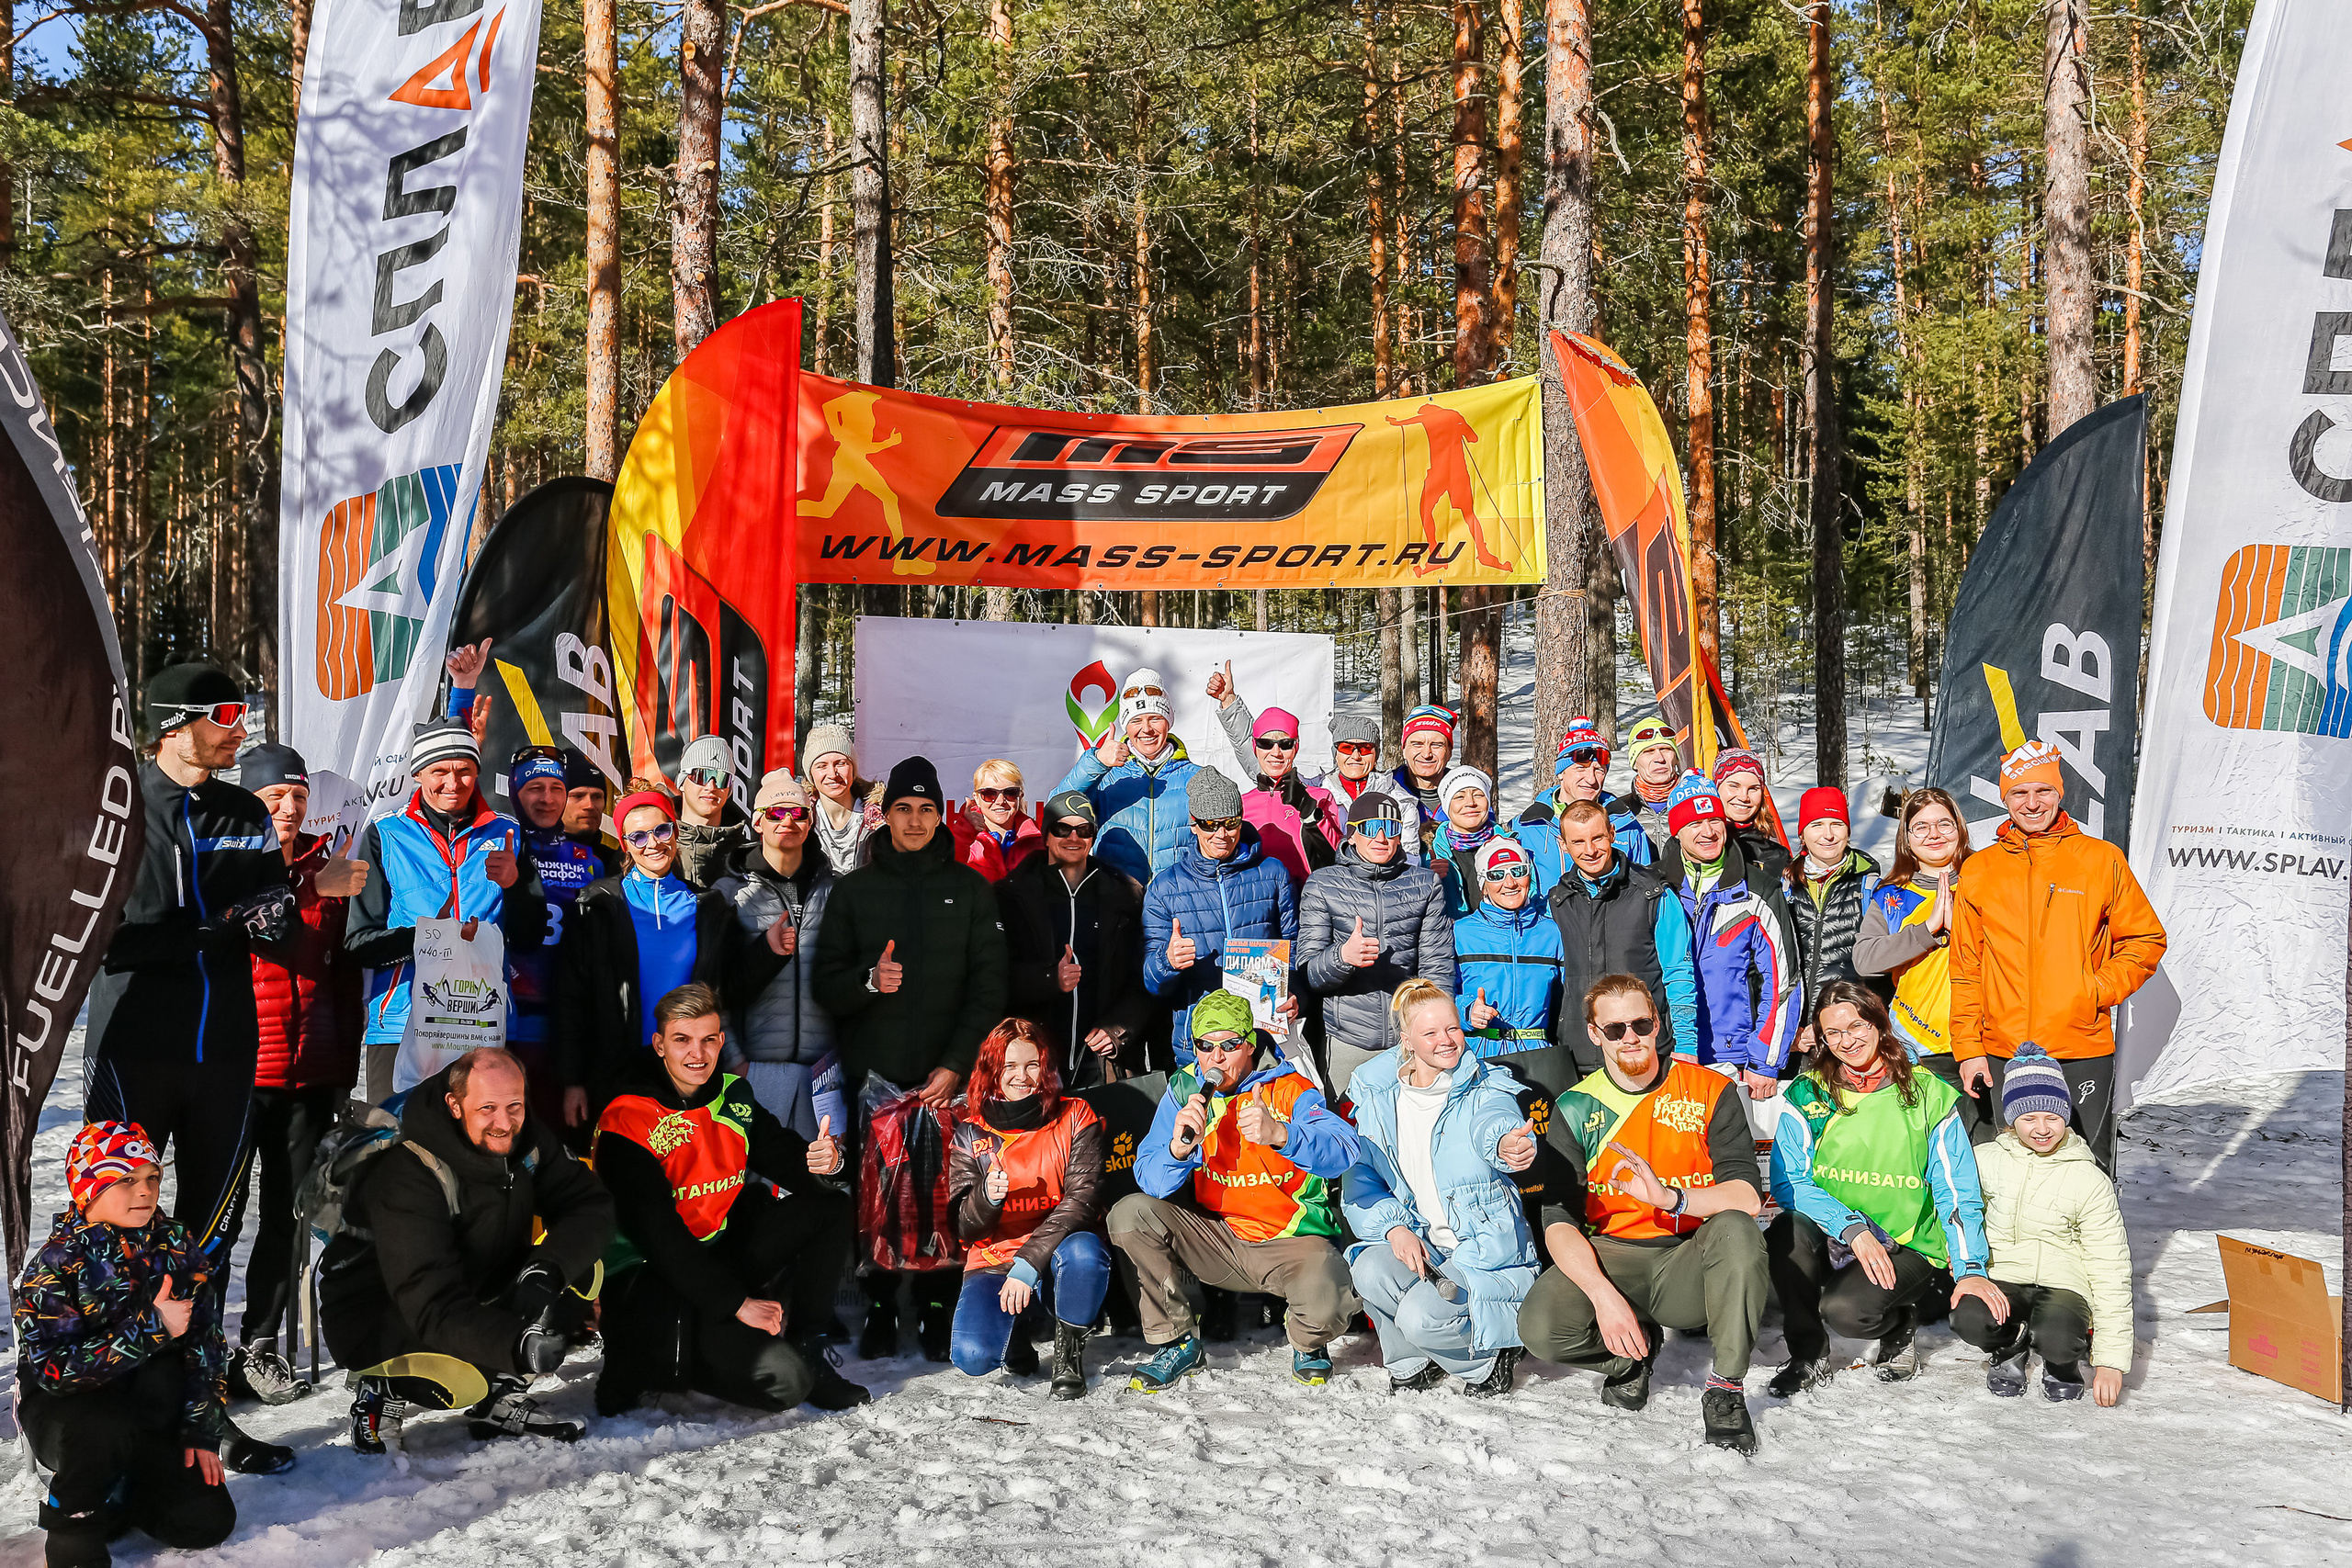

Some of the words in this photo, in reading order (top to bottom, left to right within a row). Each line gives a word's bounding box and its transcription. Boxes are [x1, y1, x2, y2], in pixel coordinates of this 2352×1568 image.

[978, 480, 1121, 504] MASS
[1134, 484, 1288, 507] SPORT
[820, 535, 1466, 570] WWW.MASS-SPORT.RU
[2008, 754, 2051, 781] special
[2171, 825, 2215, 835] ТУРИЗМ
[2226, 826, 2276, 839] ТАКТИКА
[2289, 831, 2346, 846] АКТИВНЫЙ
[12, 764, 132, 1098] FUELLED
[1225, 955, 1271, 971] ДИПЛОМ
[1813, 1164, 1924, 1190] РГАНИЗАТО
[220, 1194, 237, 1232] CRAFT
